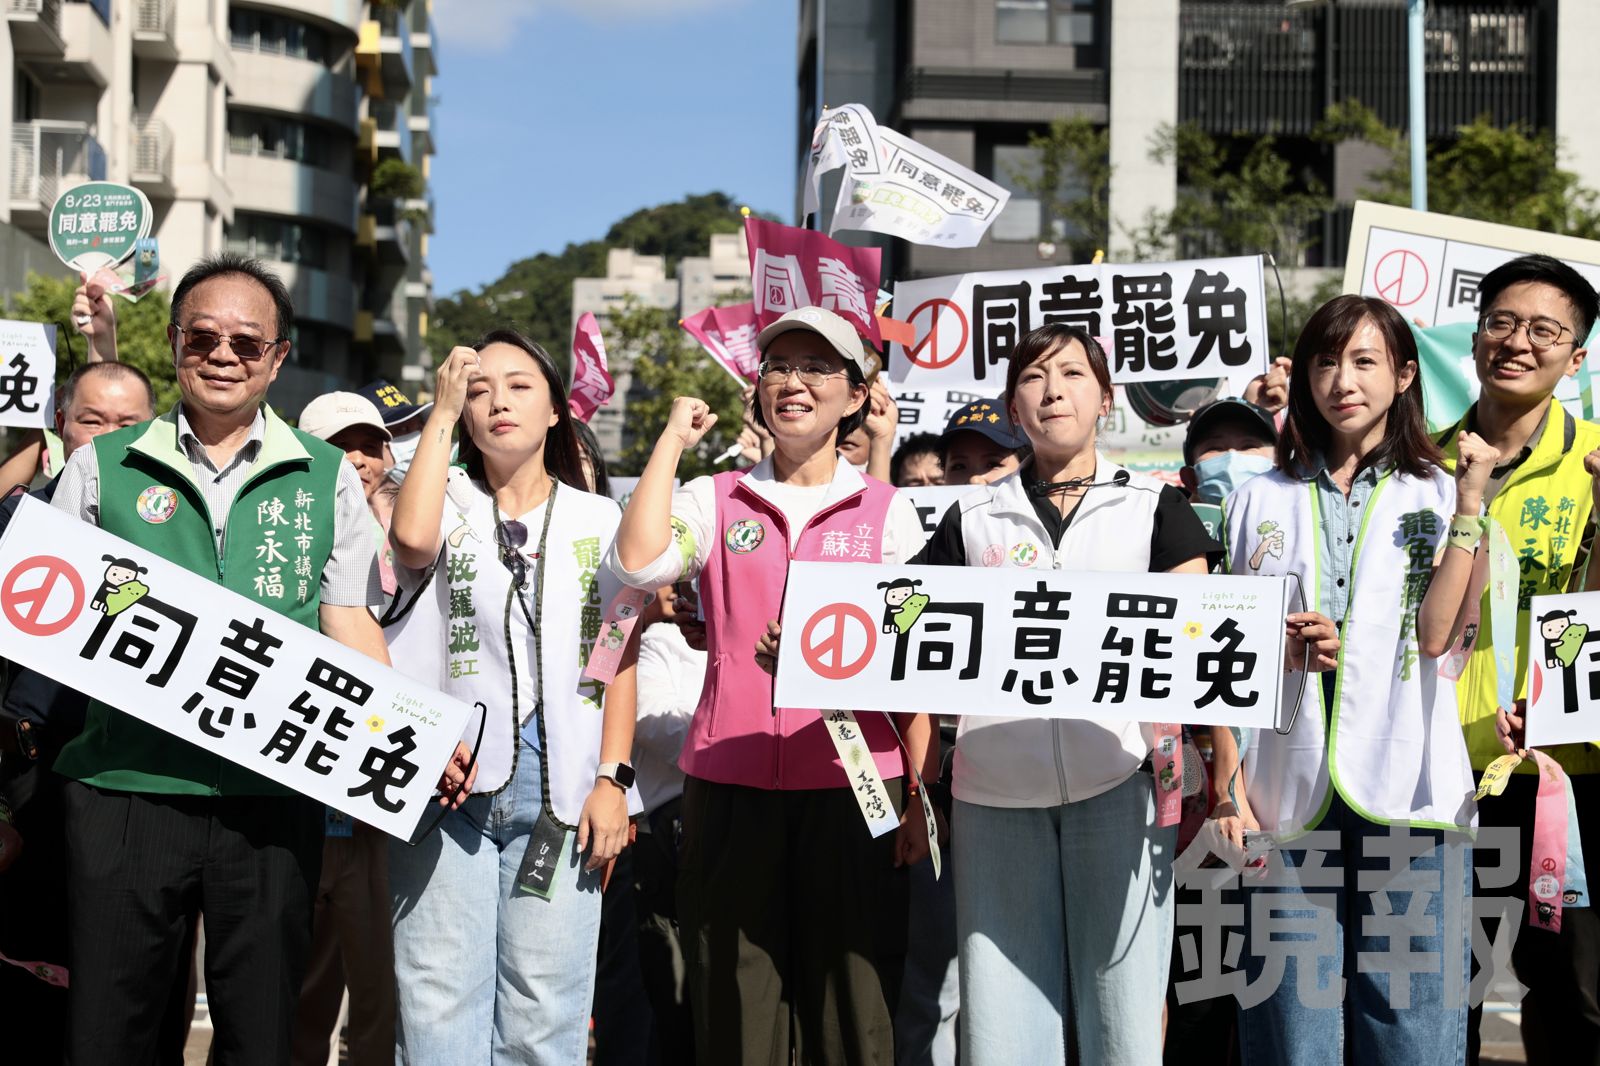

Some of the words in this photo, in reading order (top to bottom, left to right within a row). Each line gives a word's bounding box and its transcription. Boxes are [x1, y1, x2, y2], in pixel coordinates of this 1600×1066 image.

[65, 194, 101, 208] 8/23
[894, 157, 986, 215] 同意罷免
[58, 210, 137, 235] 同意罷免
[0, 353, 39, 413] 免
[254, 497, 290, 599] 陳永福
[293, 488, 315, 604] 新北市議員
[820, 530, 851, 557] 蘇
[851, 523, 874, 559] 立法
[1202, 592, 1234, 601] Light
[1242, 594, 1257, 602] up
[890, 581, 1259, 709] 同意罷免
[450, 659, 480, 679] 志工
[79, 595, 420, 814] 同意罷免
[395, 692, 424, 709] Light
[429, 708, 442, 719] up
